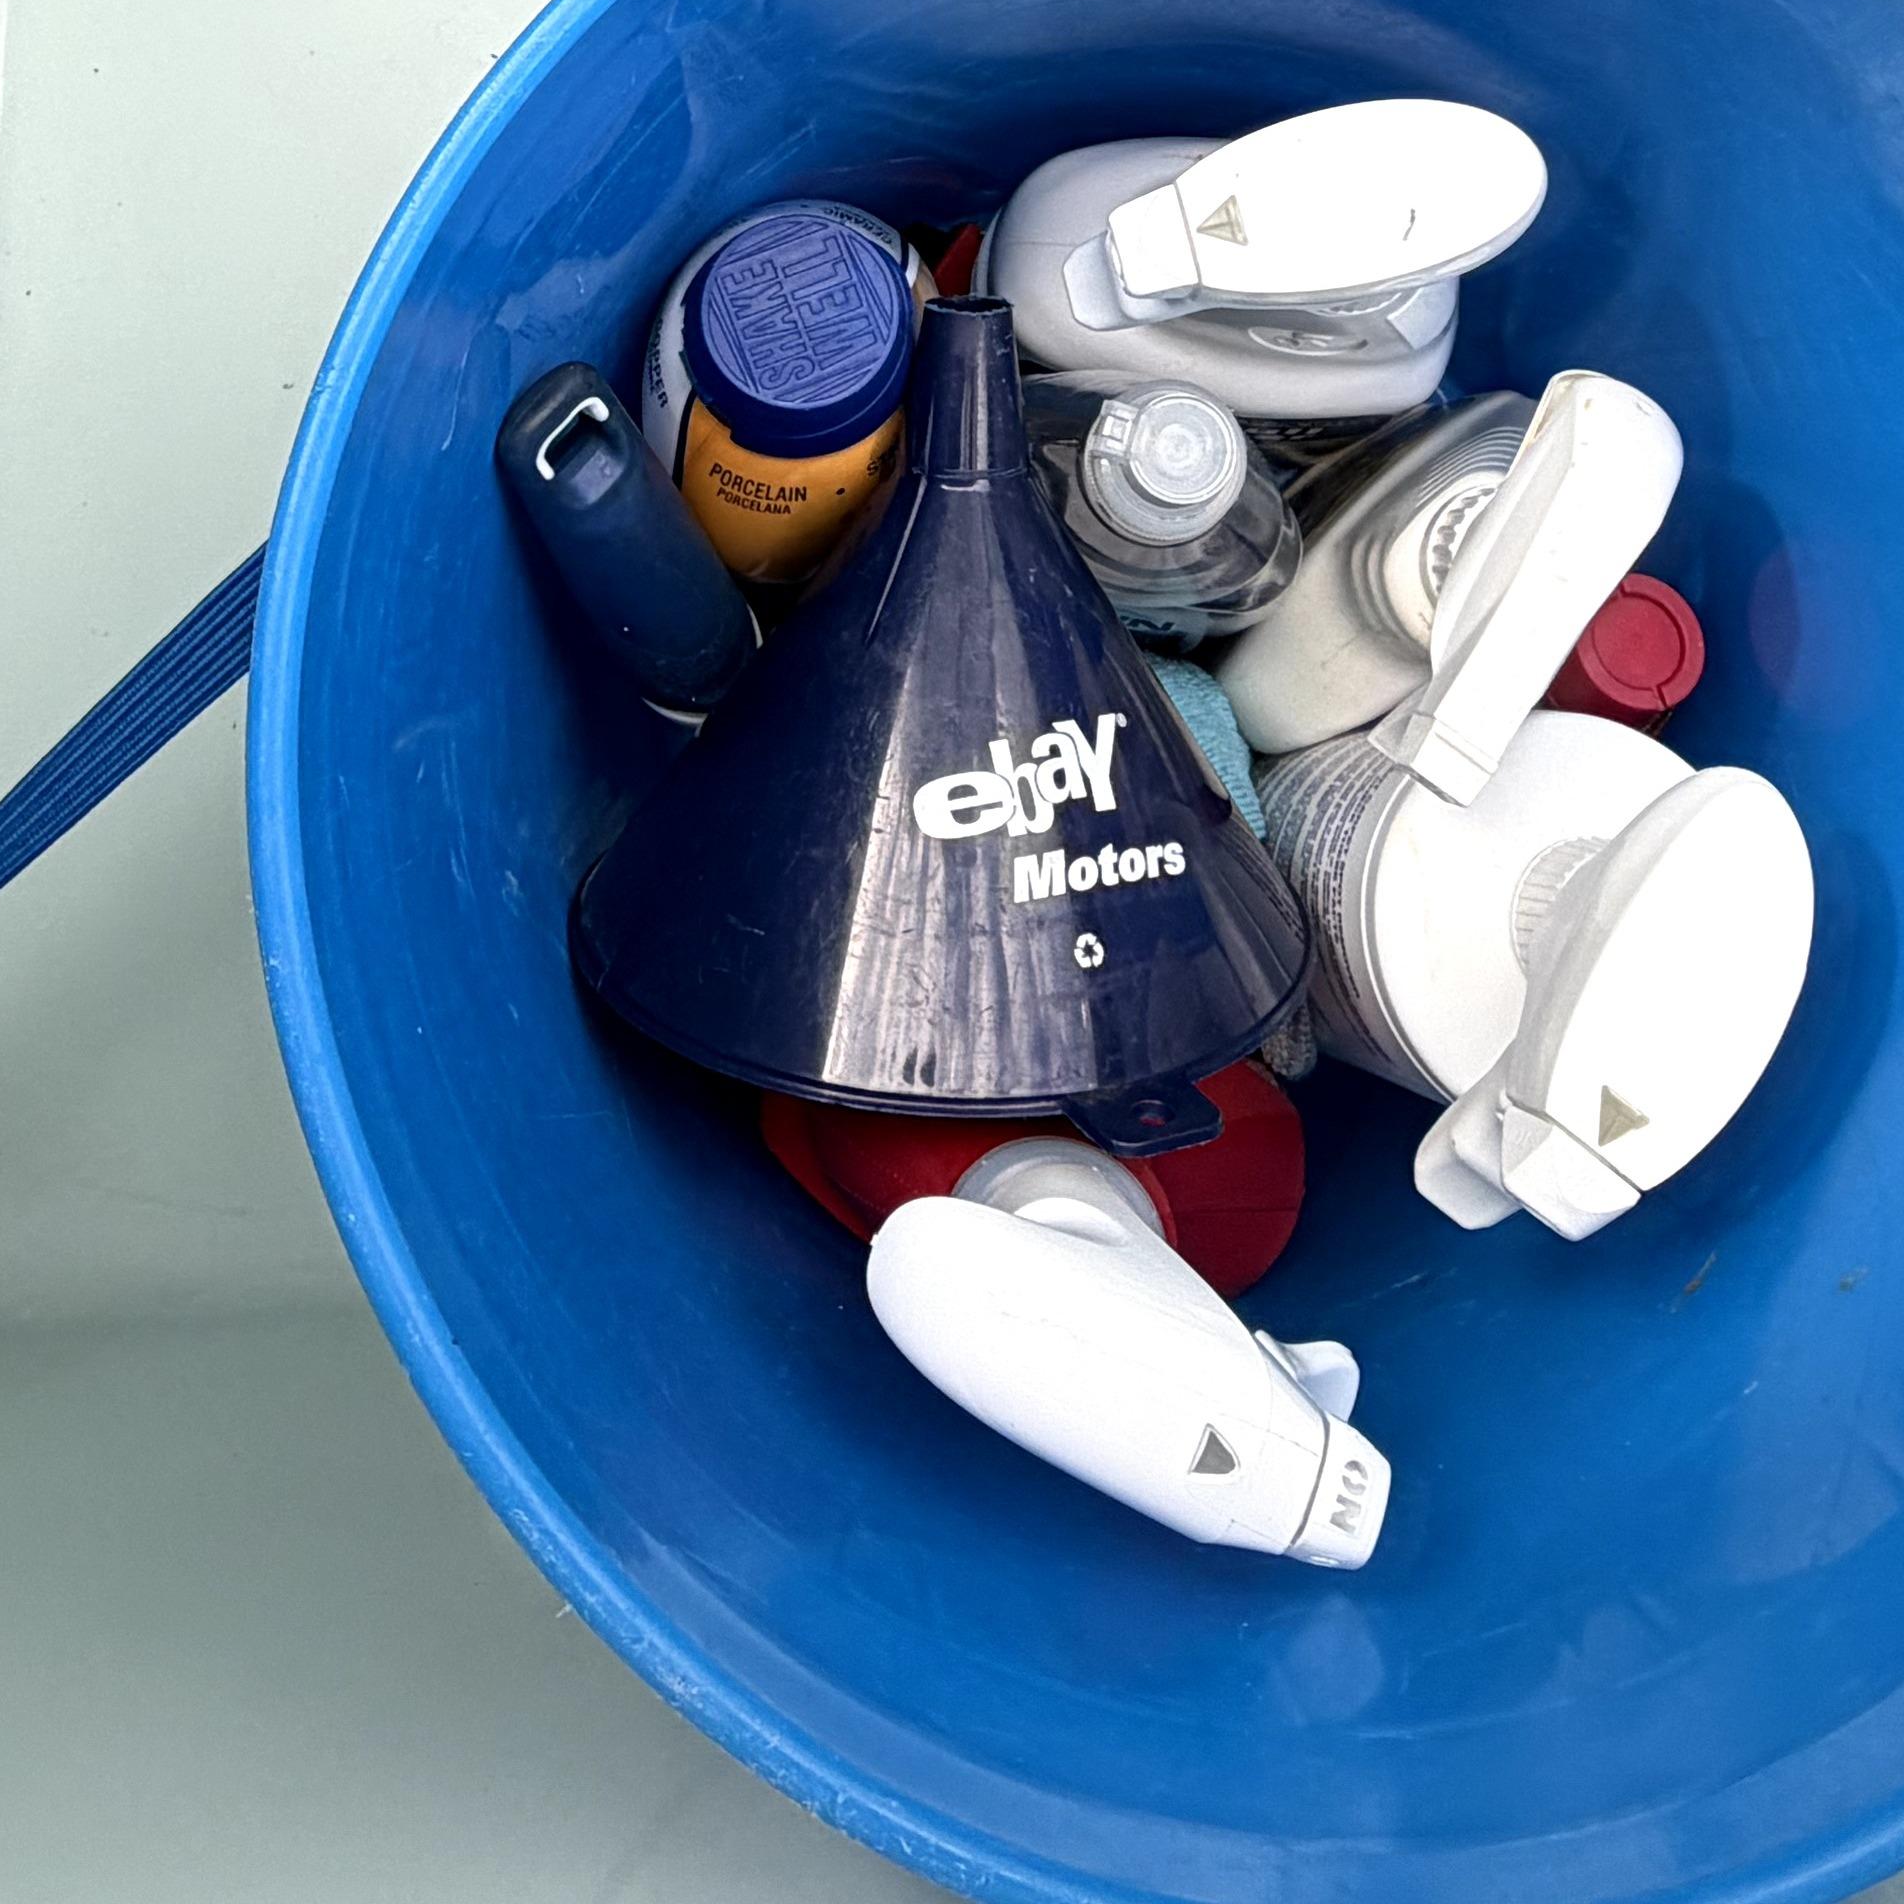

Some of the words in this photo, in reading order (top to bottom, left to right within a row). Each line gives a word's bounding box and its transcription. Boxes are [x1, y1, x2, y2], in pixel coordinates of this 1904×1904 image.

[719, 258, 815, 391] SHAKE
[782, 234, 878, 372] WELL
[708, 462, 807, 503] PORCELAIN
[716, 485, 792, 515] PORCELANA
[1013, 841, 1187, 904] Motors
